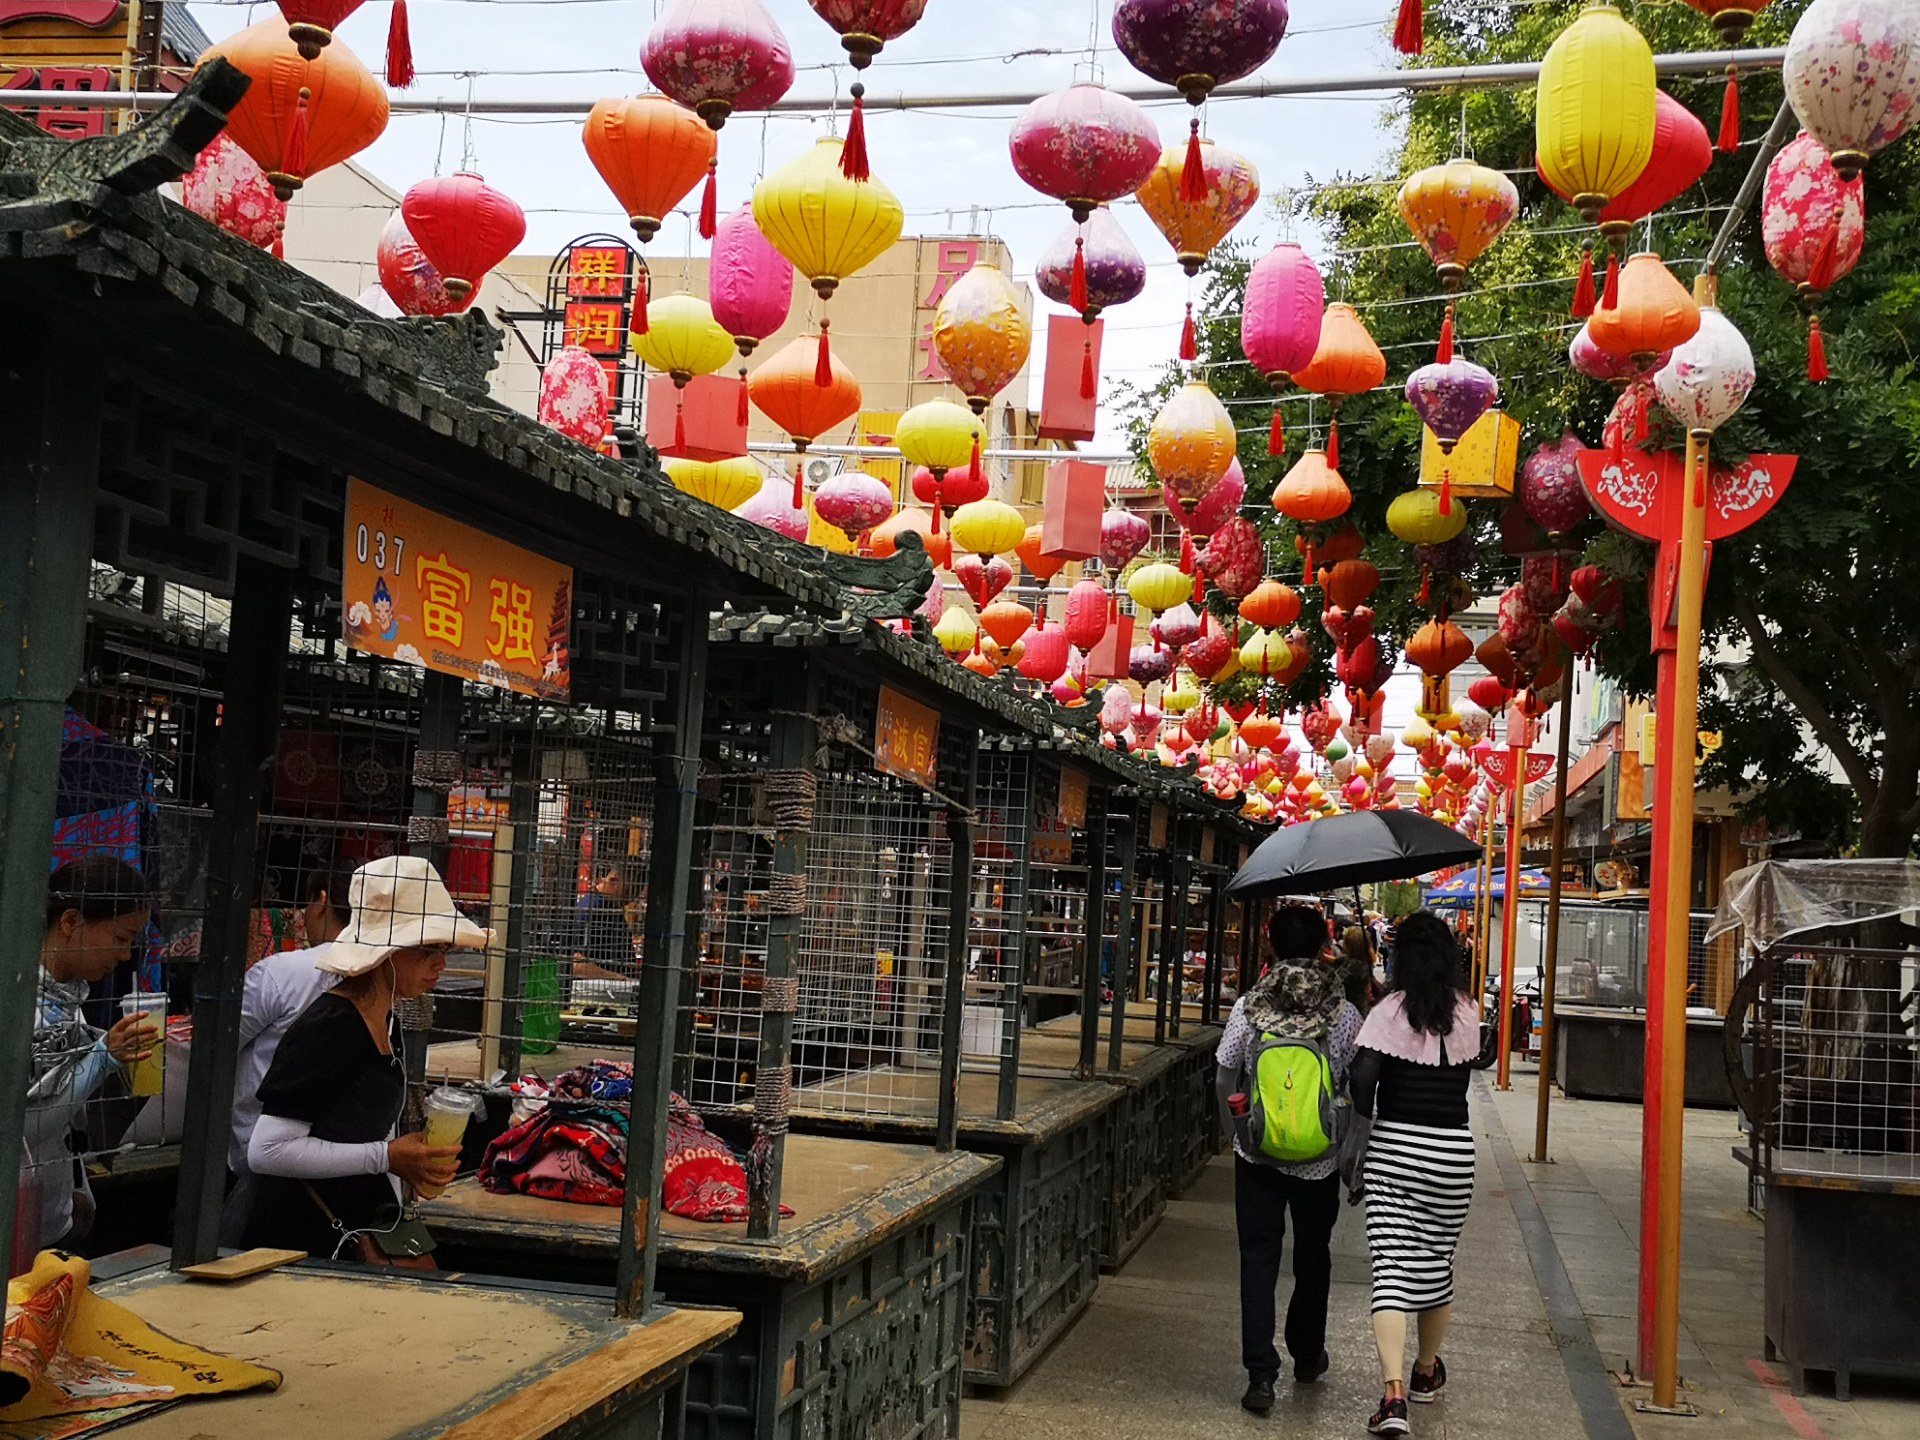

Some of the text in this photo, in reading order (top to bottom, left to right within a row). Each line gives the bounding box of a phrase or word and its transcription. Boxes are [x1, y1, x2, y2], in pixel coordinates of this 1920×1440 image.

[568, 250, 617, 348] 祥润
[357, 522, 405, 577] 037
[415, 551, 537, 666] 富强
[892, 716, 929, 768] 诚信
